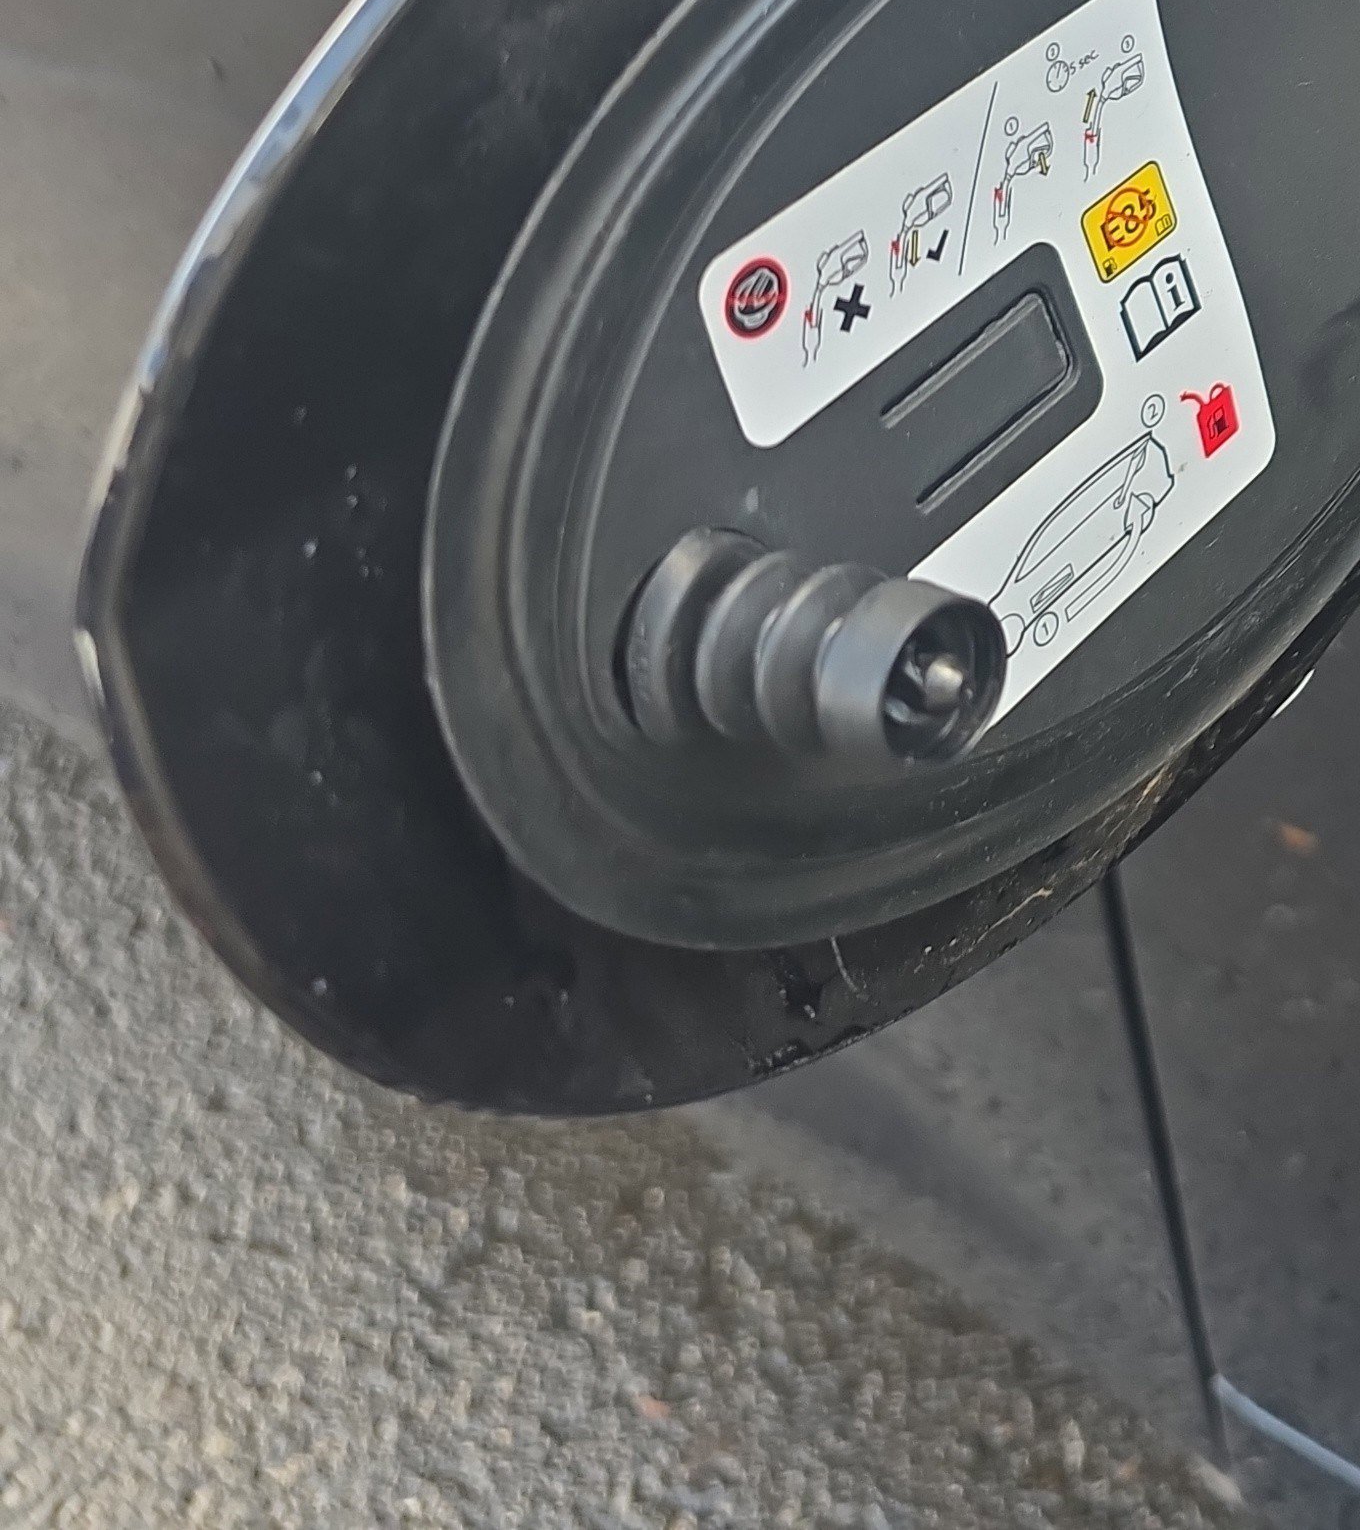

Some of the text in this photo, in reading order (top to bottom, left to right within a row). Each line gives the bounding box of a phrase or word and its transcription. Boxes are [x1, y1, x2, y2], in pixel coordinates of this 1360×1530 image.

[1069, 50, 1100, 76] 5 sec
[1100, 188, 1157, 251] E85
